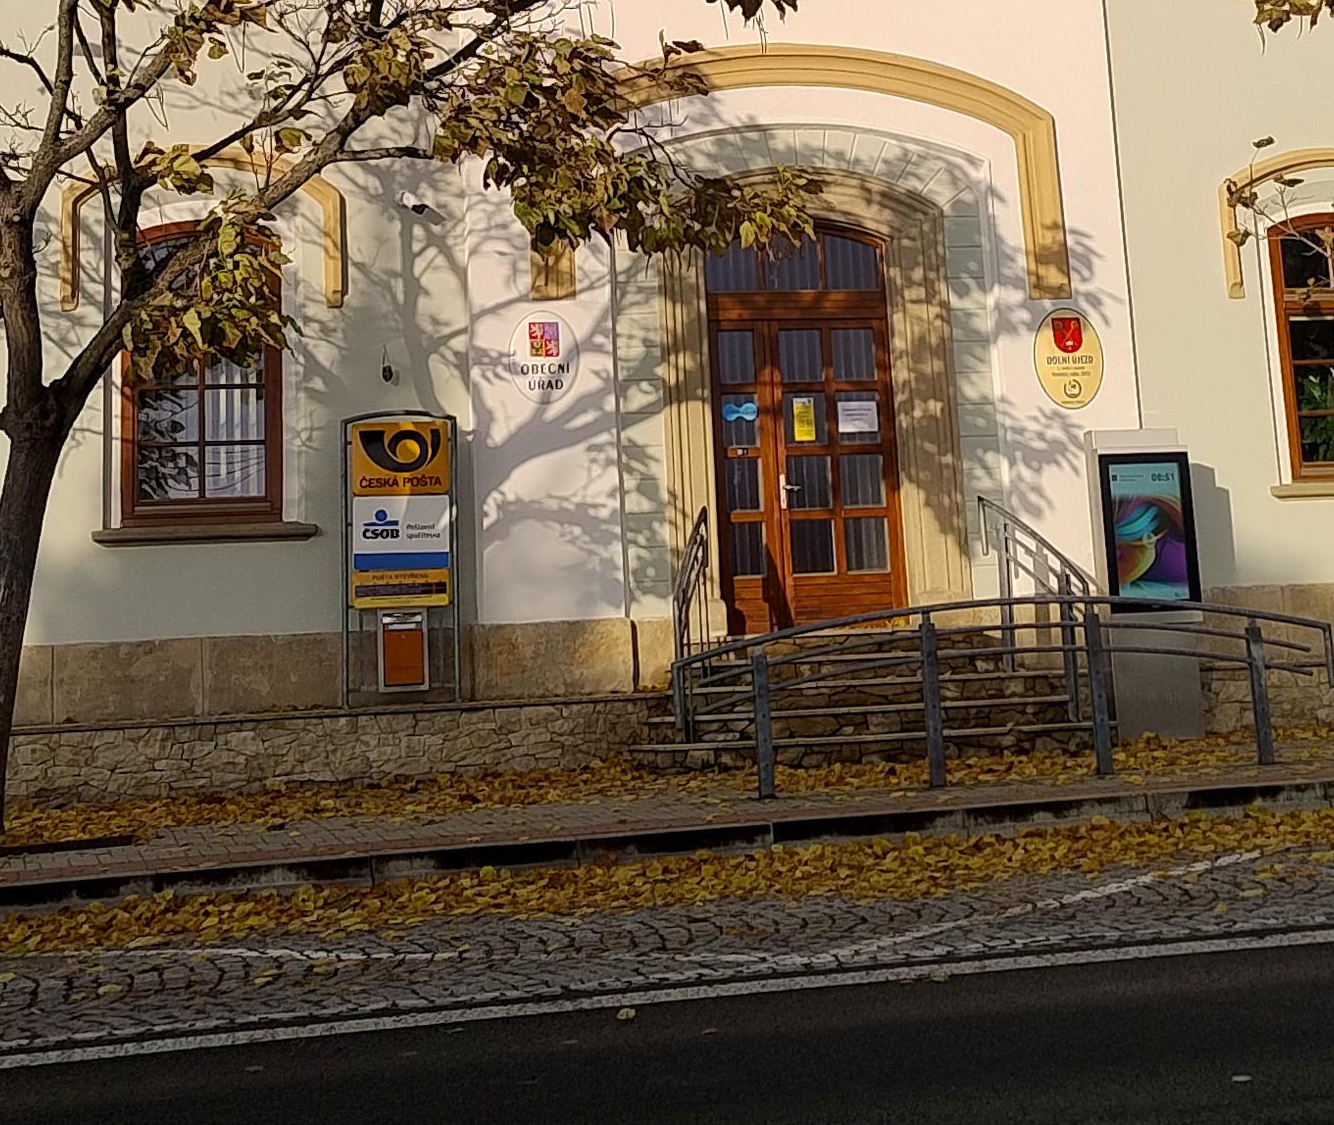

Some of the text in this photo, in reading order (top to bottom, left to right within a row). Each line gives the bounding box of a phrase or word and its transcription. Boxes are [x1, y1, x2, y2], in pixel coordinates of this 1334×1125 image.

[359, 474, 442, 488] ČESKÁ POŠTA
[362, 528, 400, 539] ČSOB
